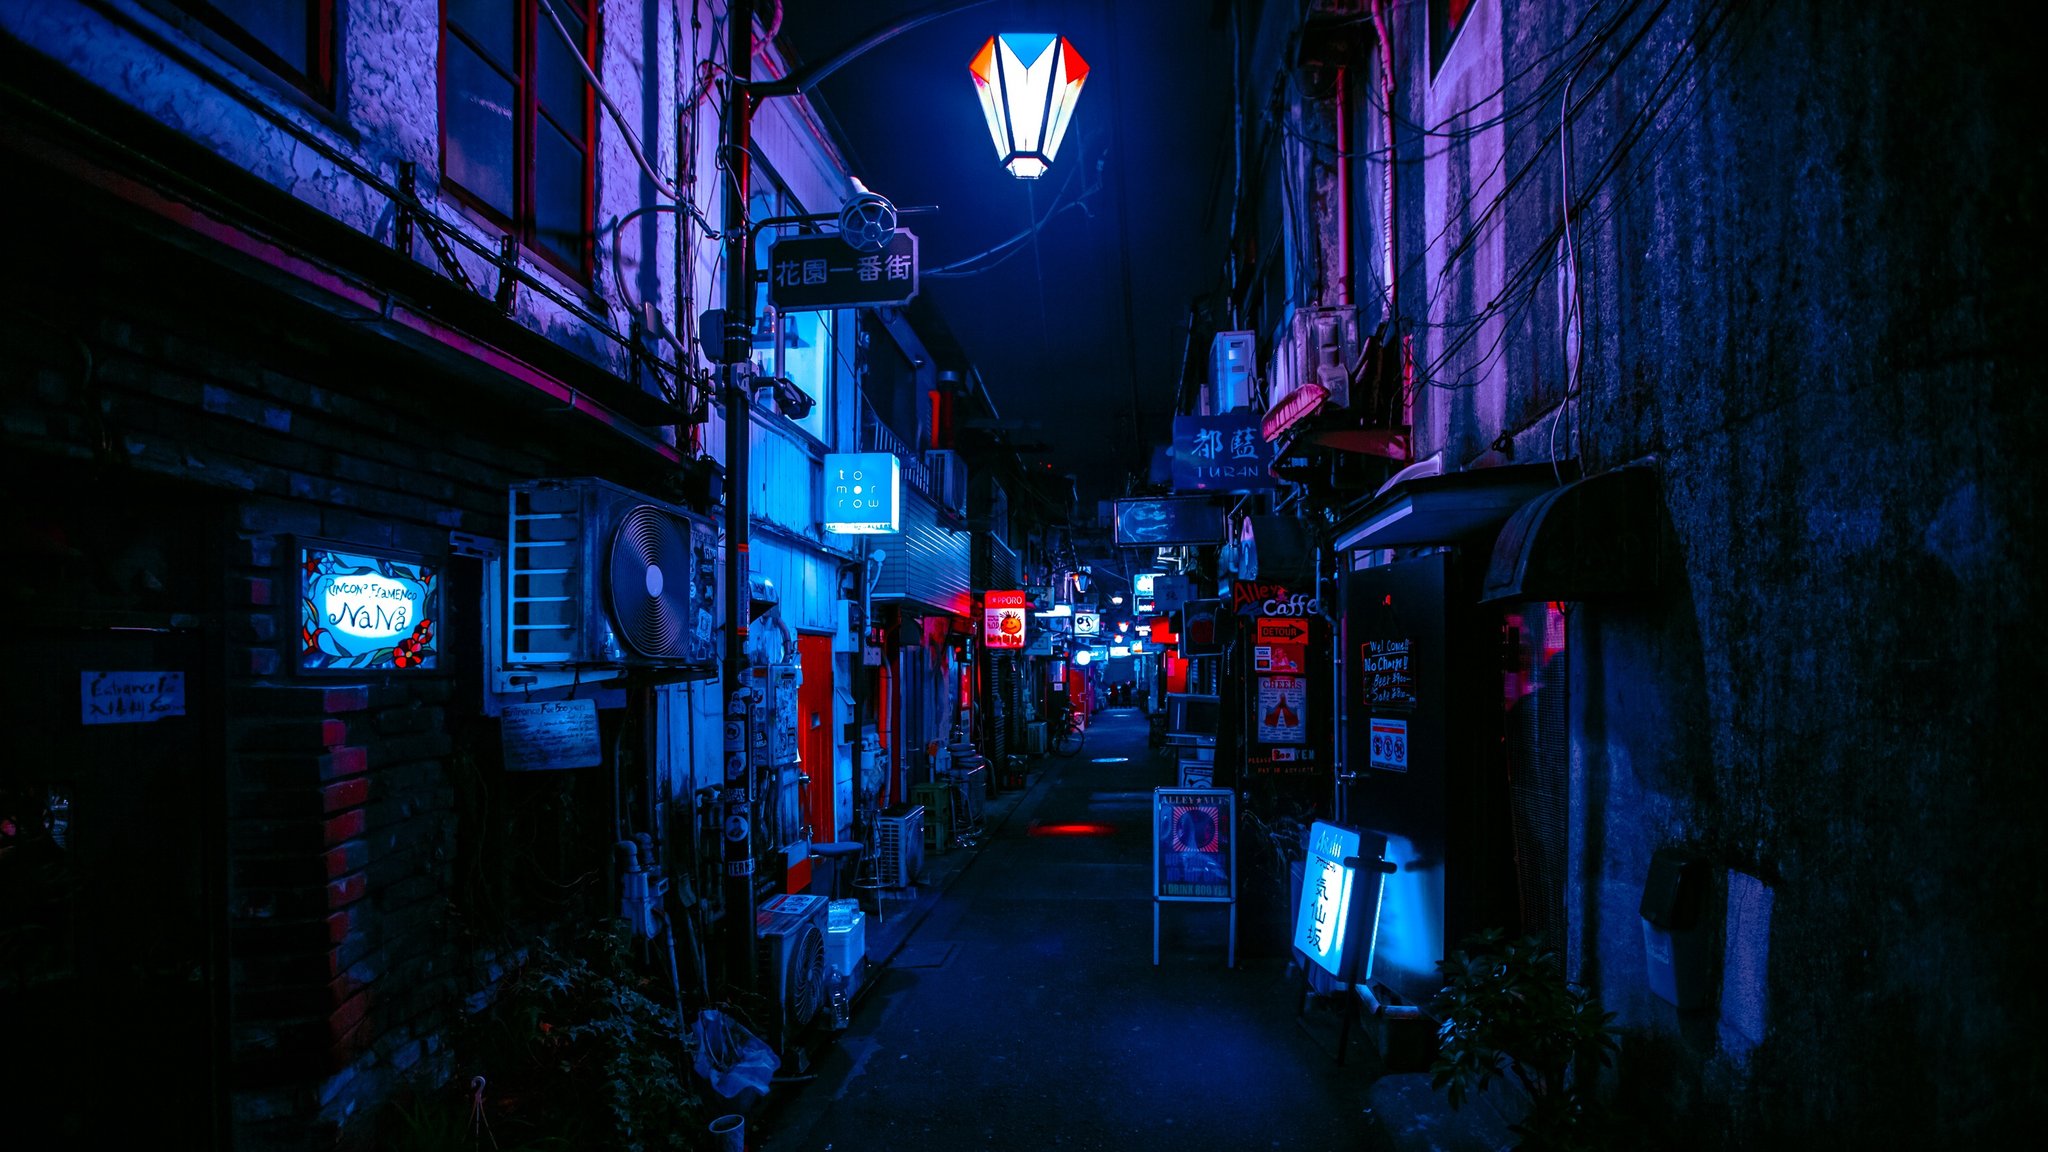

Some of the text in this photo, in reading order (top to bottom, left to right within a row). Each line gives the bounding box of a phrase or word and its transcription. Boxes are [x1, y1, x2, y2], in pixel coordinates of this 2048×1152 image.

[776, 254, 912, 287] 花園一番街
[1195, 465, 1258, 478] TURAN
[1262, 626, 1297, 636] DETOUR
[1262, 680, 1302, 689] CHEERS
[1161, 795, 1194, 805] ALLEY
[1168, 884, 1194, 896] DRINK
[1307, 878, 1329, 952] 気仙坂
